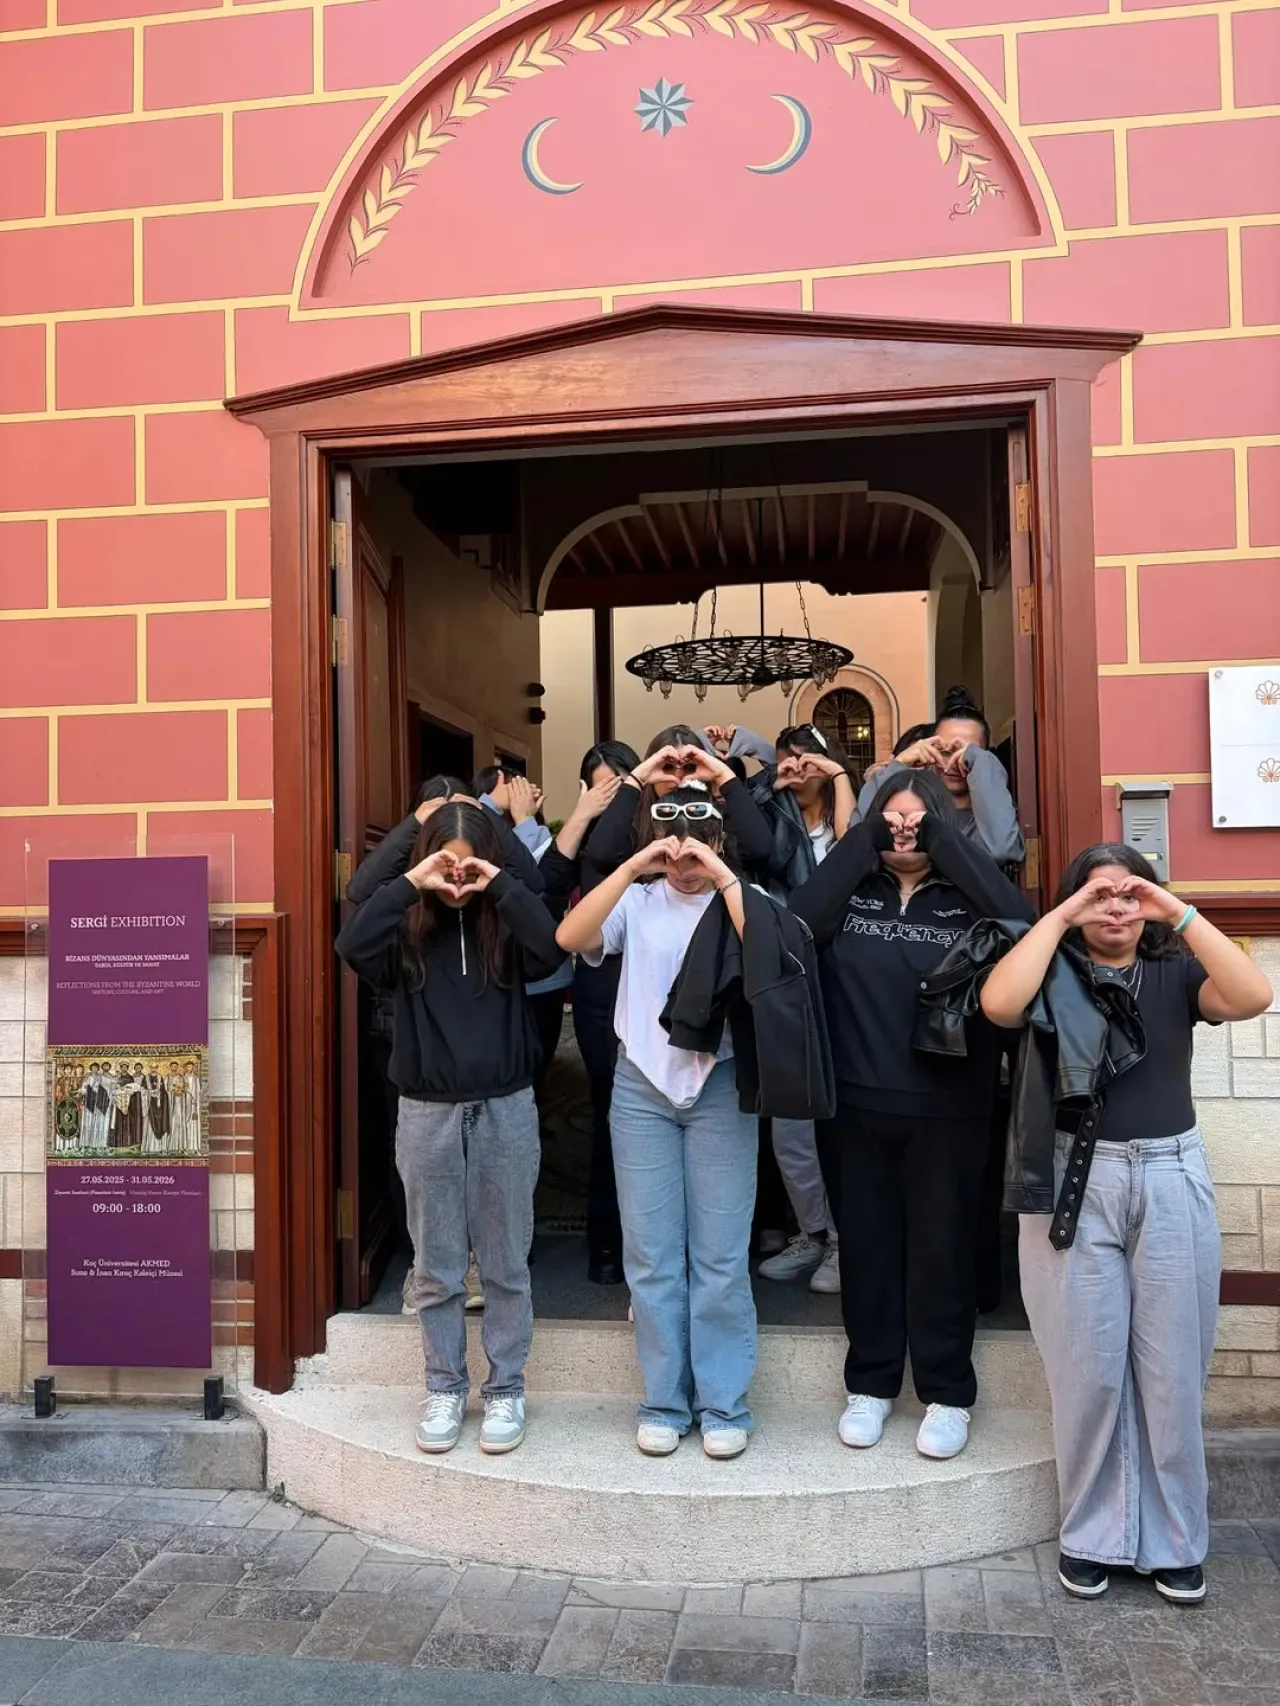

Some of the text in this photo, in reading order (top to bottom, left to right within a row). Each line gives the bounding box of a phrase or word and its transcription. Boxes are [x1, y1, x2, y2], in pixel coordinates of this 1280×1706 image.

[71, 915, 186, 928] SERGİ EXHIBITION
[81, 1175, 125, 1184] 27.05.2025
[131, 1175, 175, 1184] 31.05.2026
[92, 1203, 123, 1213] 09:00
[132, 1203, 161, 1213] 18:00
[83, 1259, 97, 1268] Koç
[140, 1259, 171, 1267] AKMED
